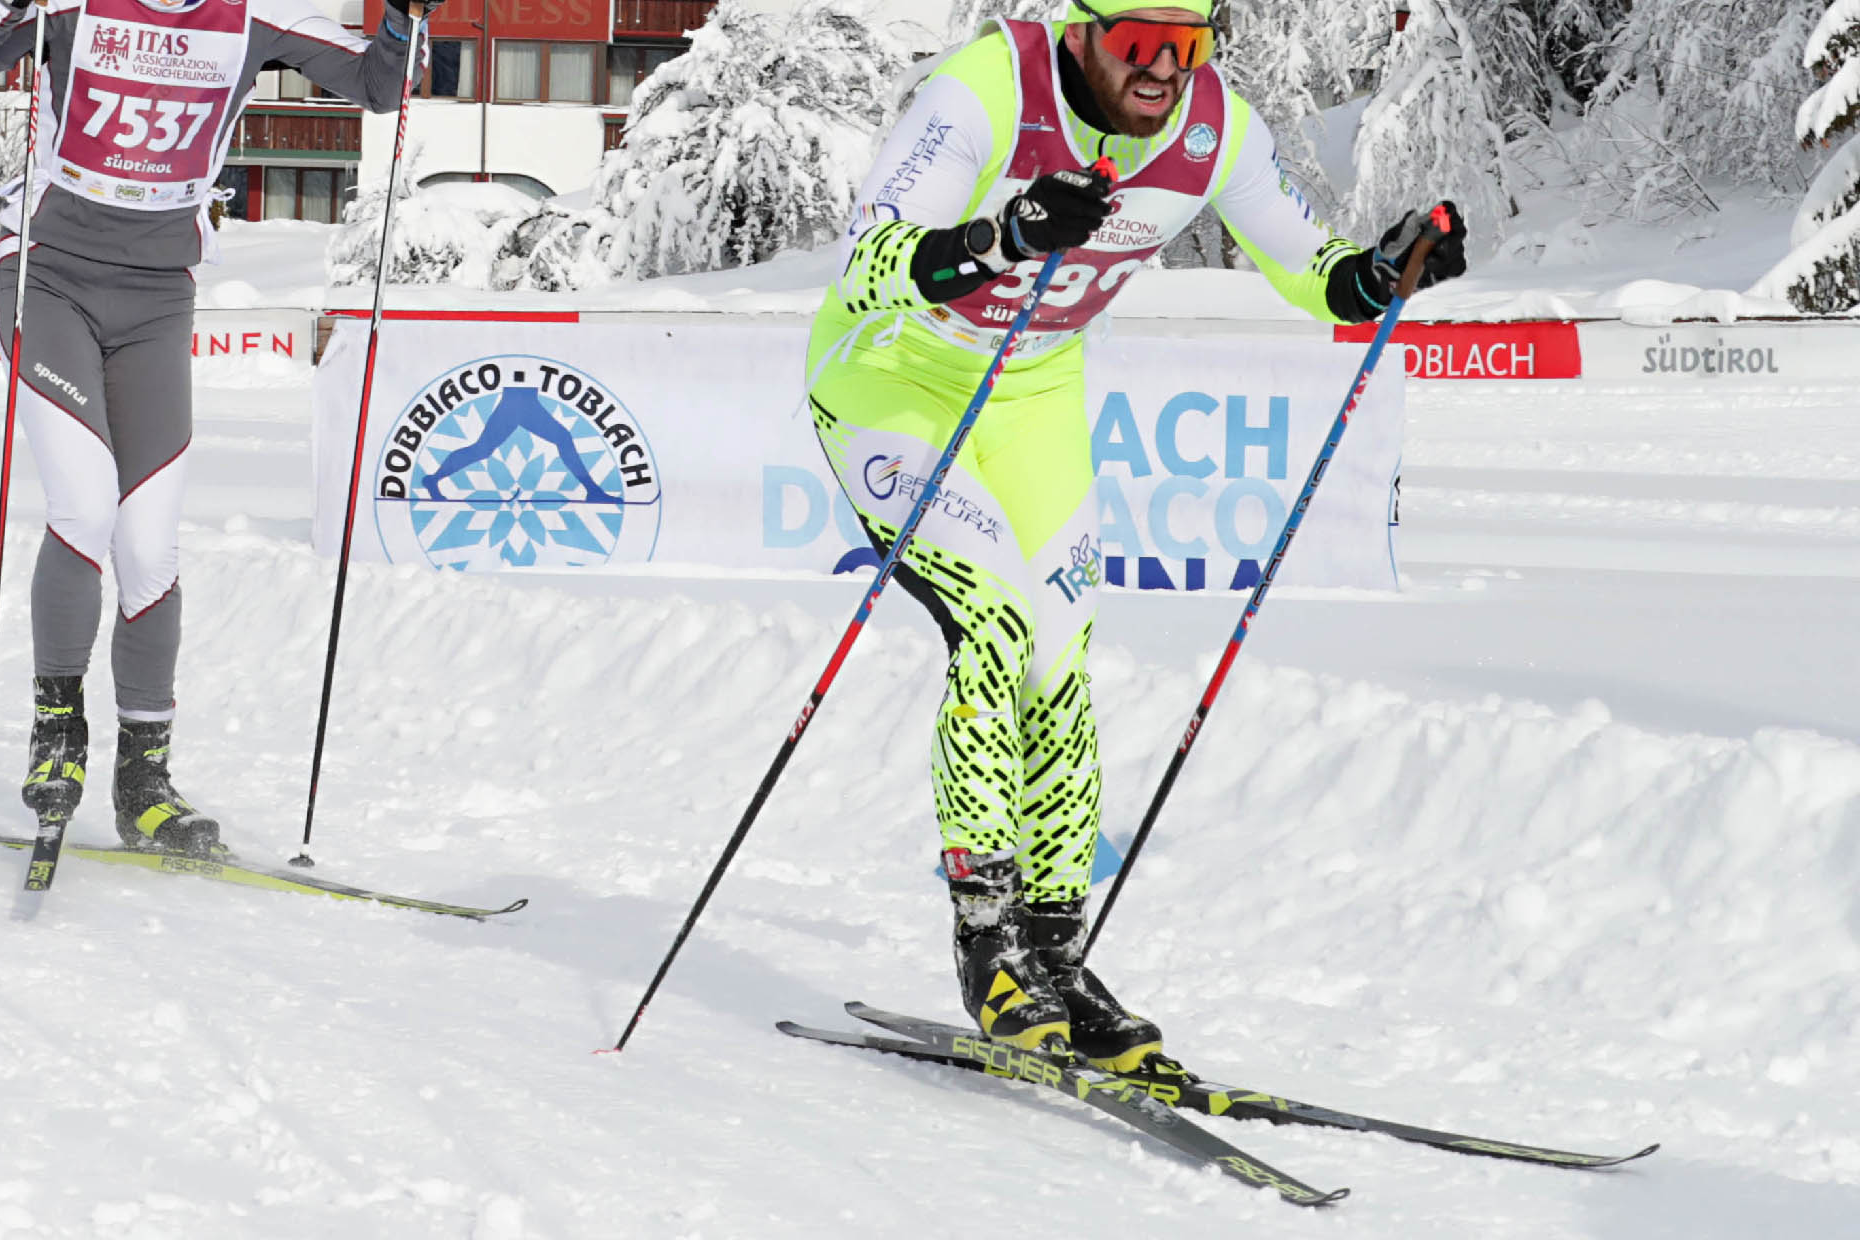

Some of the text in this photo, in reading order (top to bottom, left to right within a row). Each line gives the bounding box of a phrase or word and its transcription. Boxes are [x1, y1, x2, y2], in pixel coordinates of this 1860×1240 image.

[136, 30, 189, 56] ITAS
[132, 64, 227, 83] VERSICHERUNGEN
[133, 54, 218, 71] ASSICURAZIONI
[82, 87, 215, 153] 7537
[1404, 343, 1535, 376] OBLACH
[33, 362, 88, 406] sportful
[381, 363, 652, 499] DOBBIACO TOBLACH
[161, 856, 223, 876] FISCHER
[953, 1036, 1063, 1090] FISCHER
